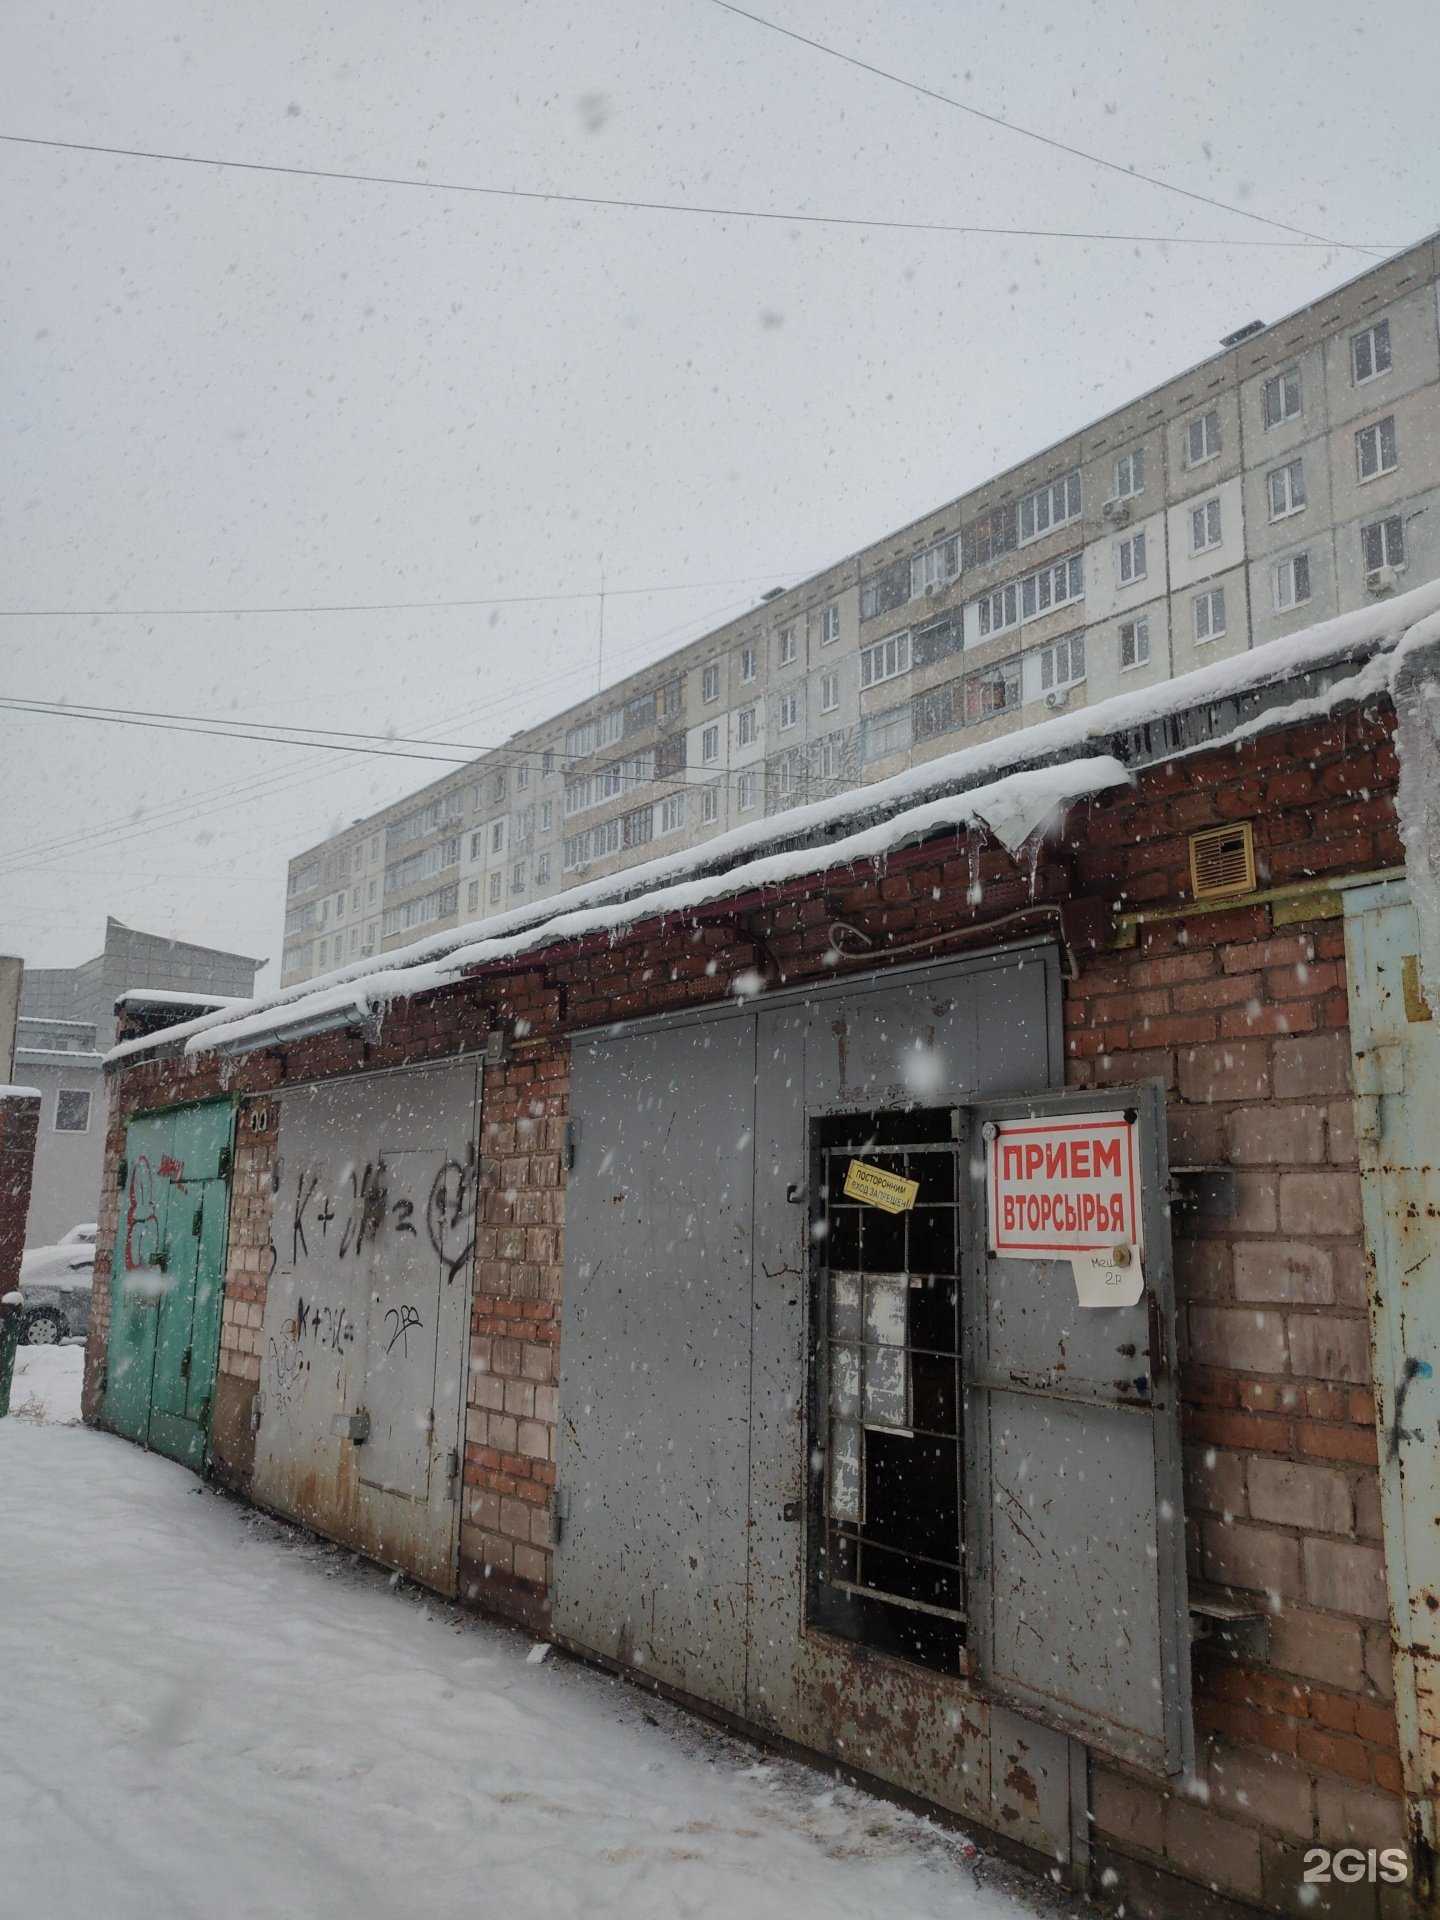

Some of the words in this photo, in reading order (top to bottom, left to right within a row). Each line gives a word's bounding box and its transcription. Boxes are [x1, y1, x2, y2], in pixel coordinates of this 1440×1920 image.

[1003, 1138, 1122, 1181] ПРИЕМ
[851, 1179, 869, 1196] ВХОД
[855, 1169, 907, 1193] ПОСТОРОННИМ
[1003, 1193, 1125, 1232] ВТОРСЫРЬЯ
